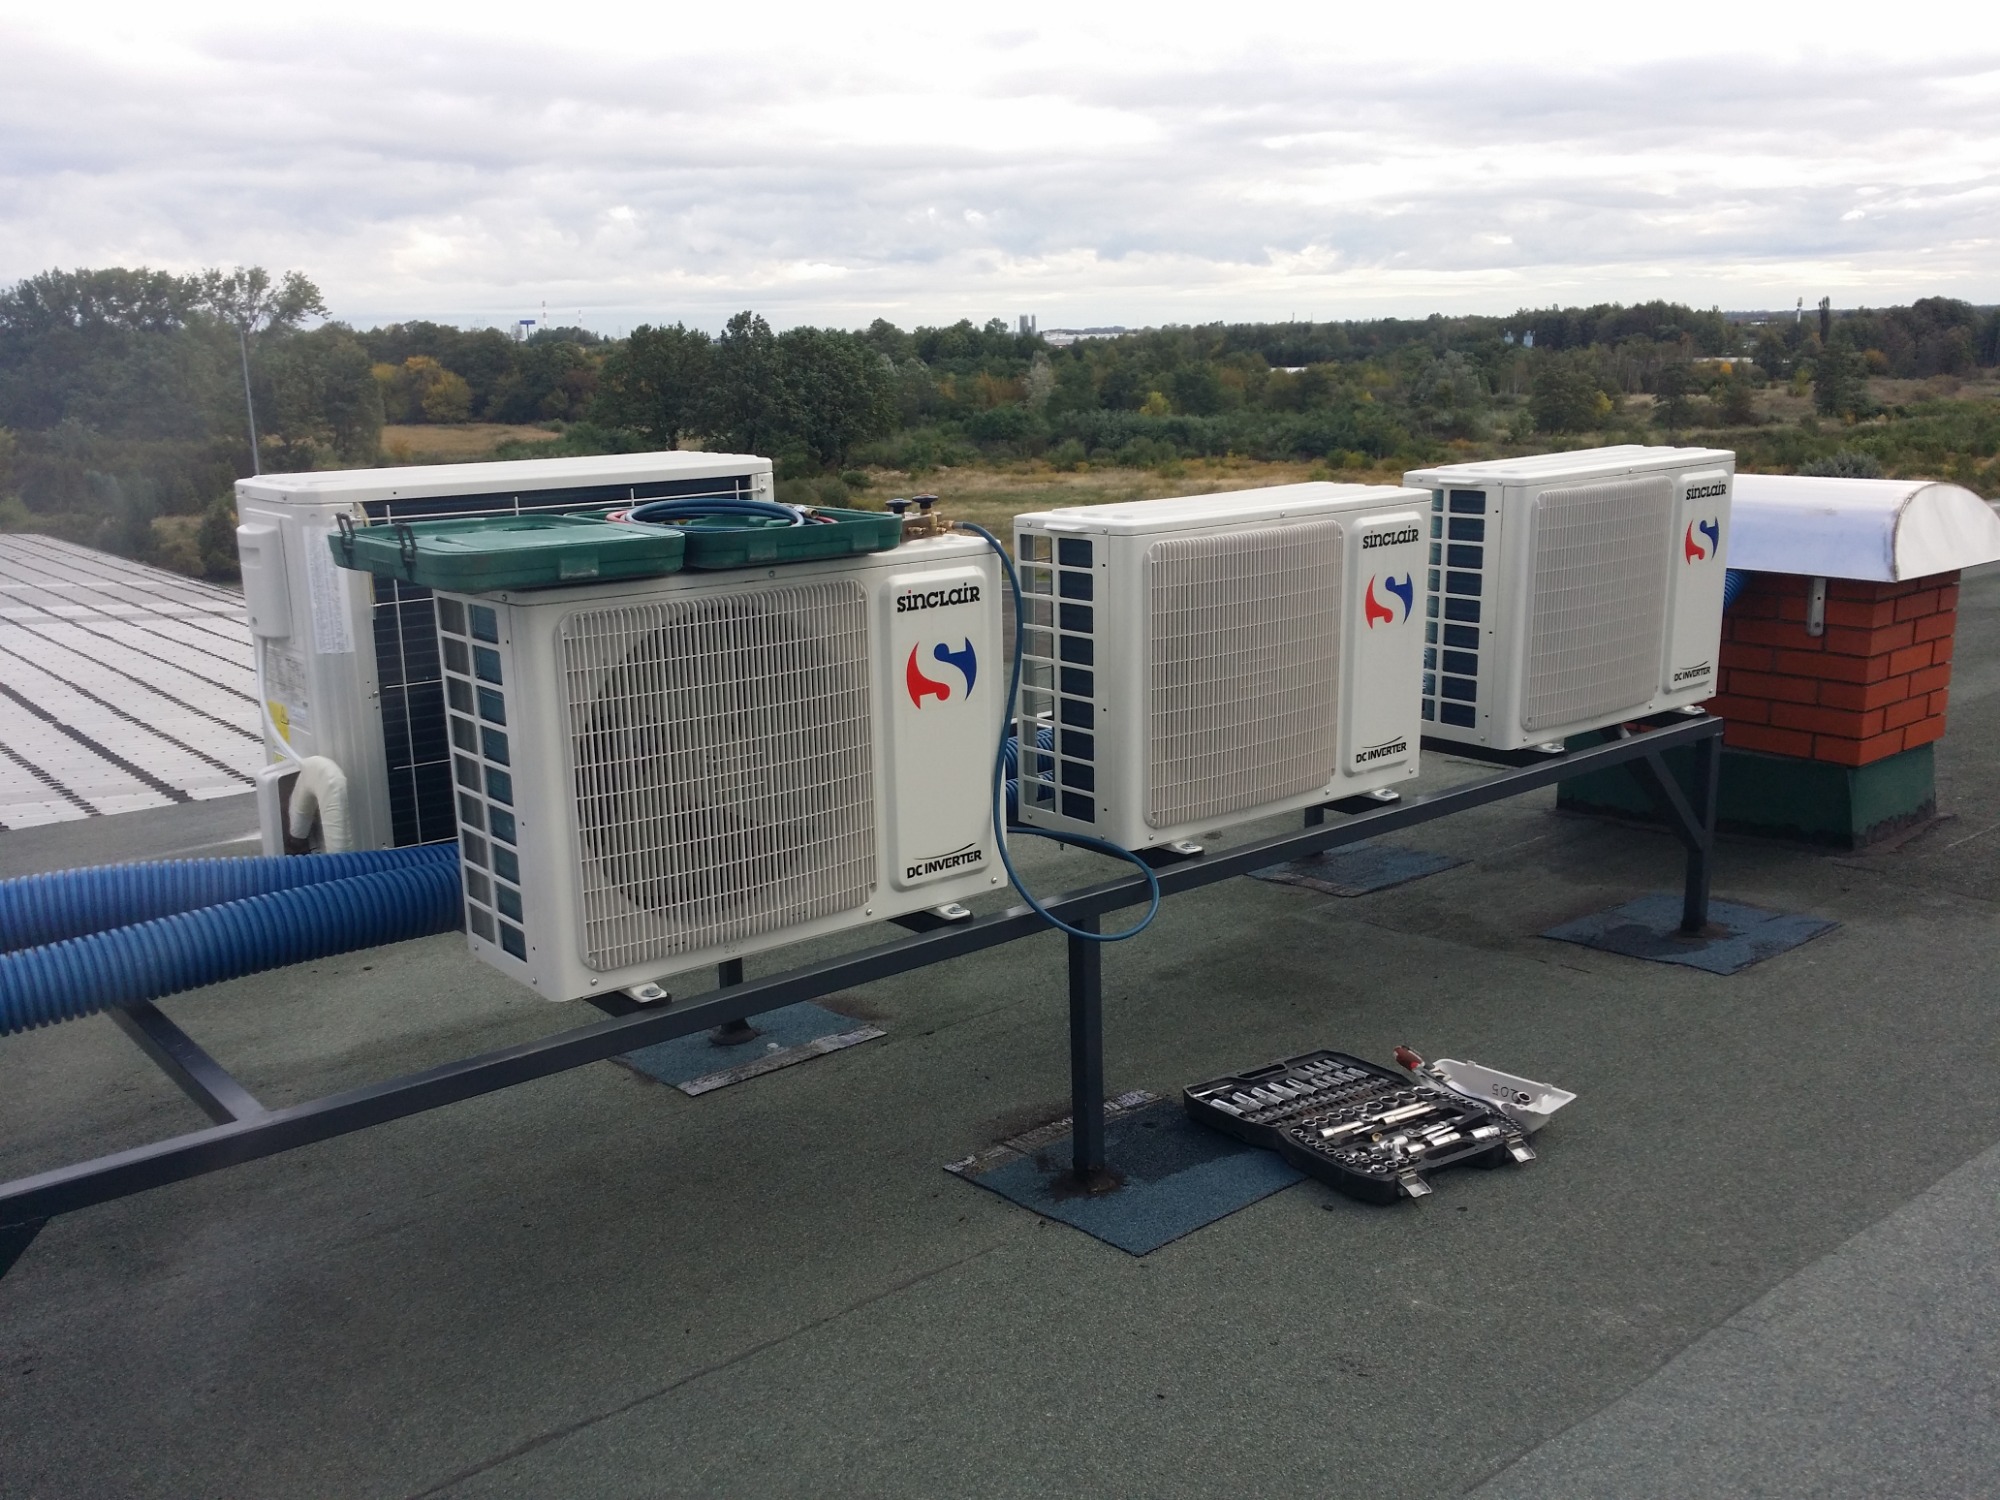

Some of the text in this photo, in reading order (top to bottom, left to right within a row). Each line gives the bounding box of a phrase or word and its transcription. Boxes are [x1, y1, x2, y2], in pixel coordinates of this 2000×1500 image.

[1674, 666, 1711, 682] DC INVERTER
[1356, 741, 1407, 763] DC INVERTER
[906, 850, 982, 879] DC INVERTER
